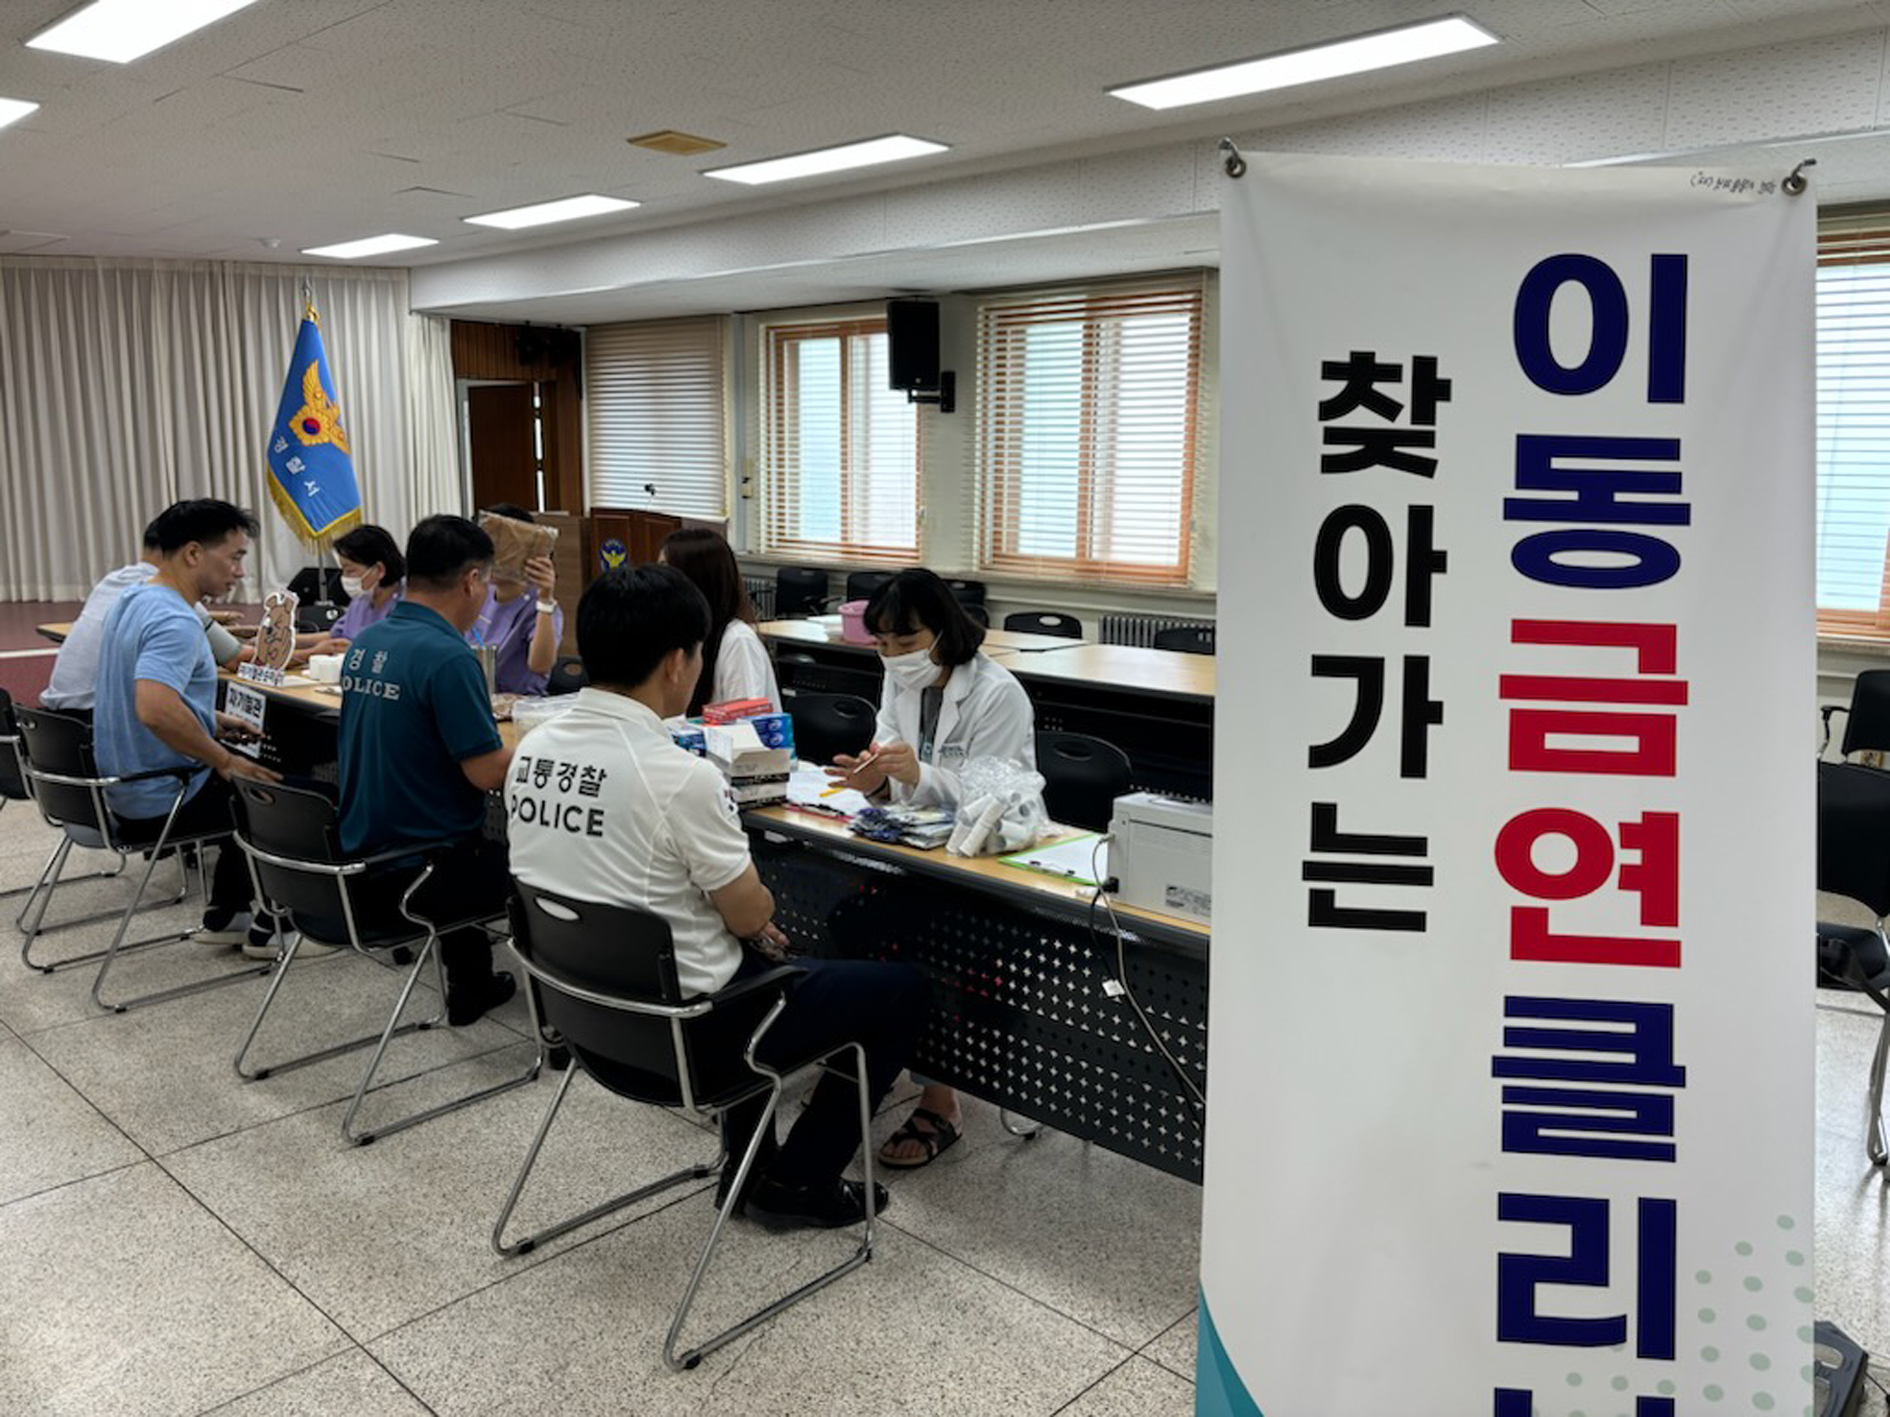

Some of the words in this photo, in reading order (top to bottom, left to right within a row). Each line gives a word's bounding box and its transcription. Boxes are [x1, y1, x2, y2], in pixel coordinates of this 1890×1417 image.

[1303, 351, 1452, 932] 찾아가는
[349, 648, 389, 674] 경찰
[341, 675, 400, 700] OLICE
[515, 755, 607, 798] 교통경찰
